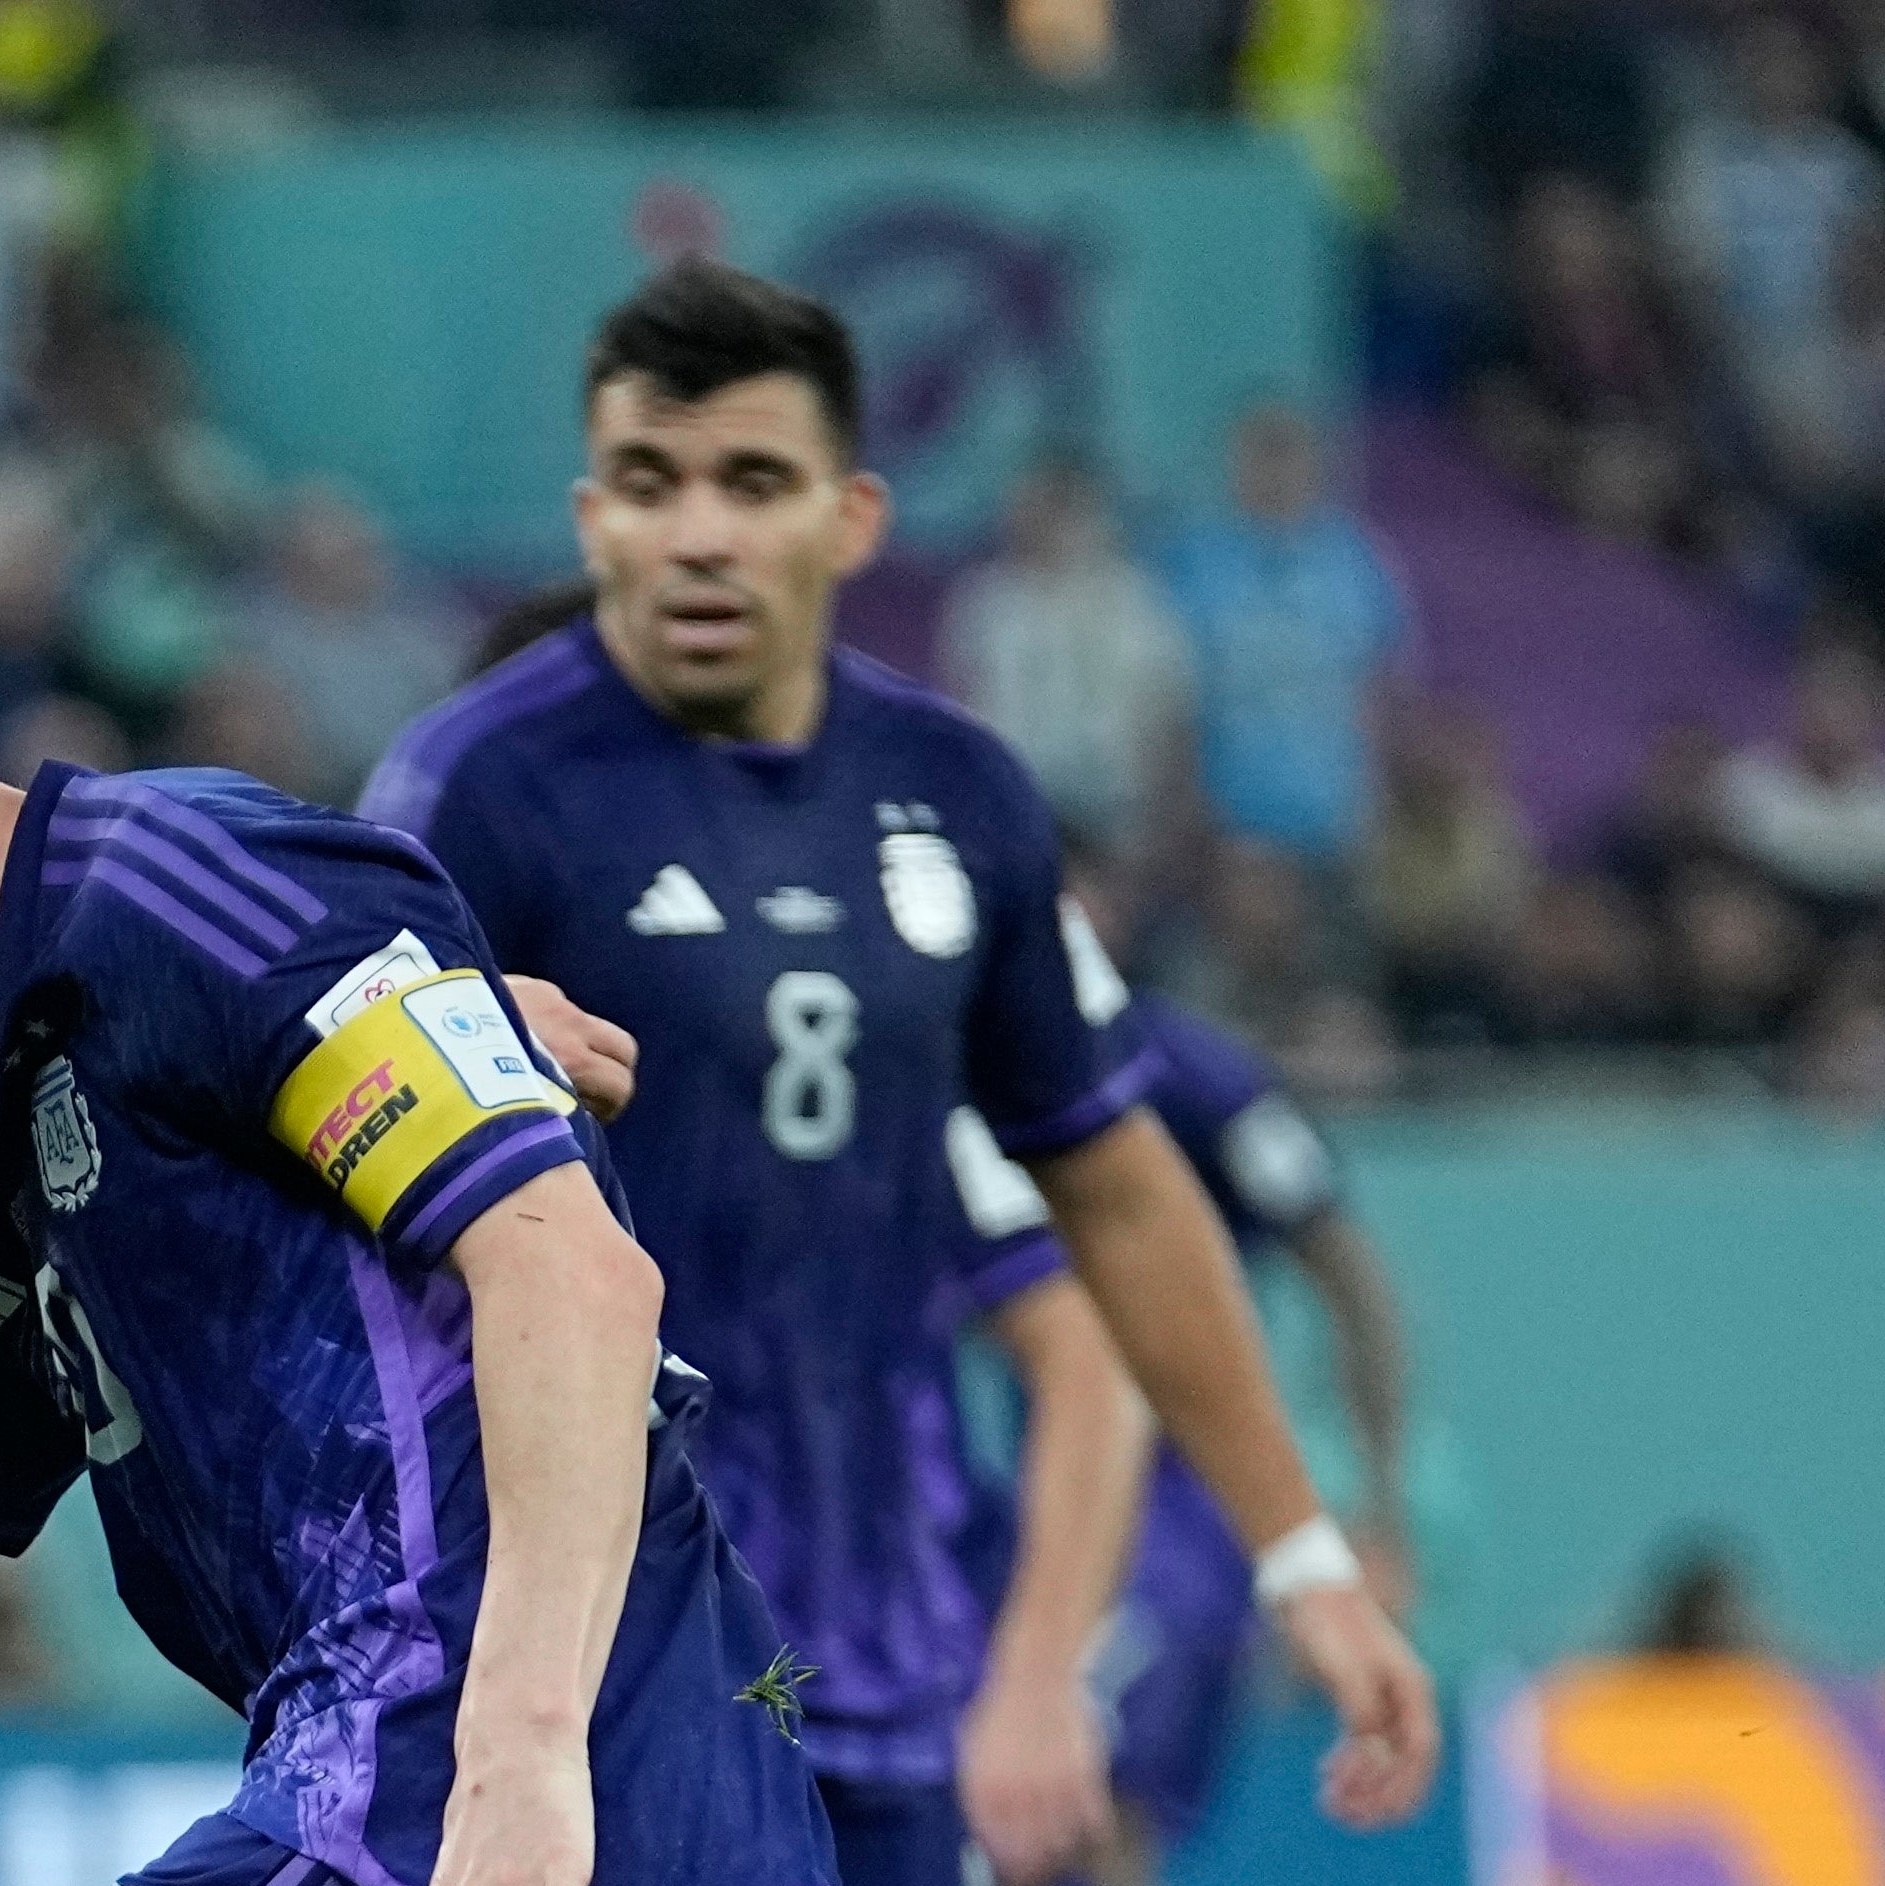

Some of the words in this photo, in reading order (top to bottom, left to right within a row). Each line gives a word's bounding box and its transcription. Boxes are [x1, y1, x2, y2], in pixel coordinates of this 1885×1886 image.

[305, 1058, 395, 1171] TECT
[763, 971, 863, 1160] 8
[328, 1083, 420, 1192] DREN
